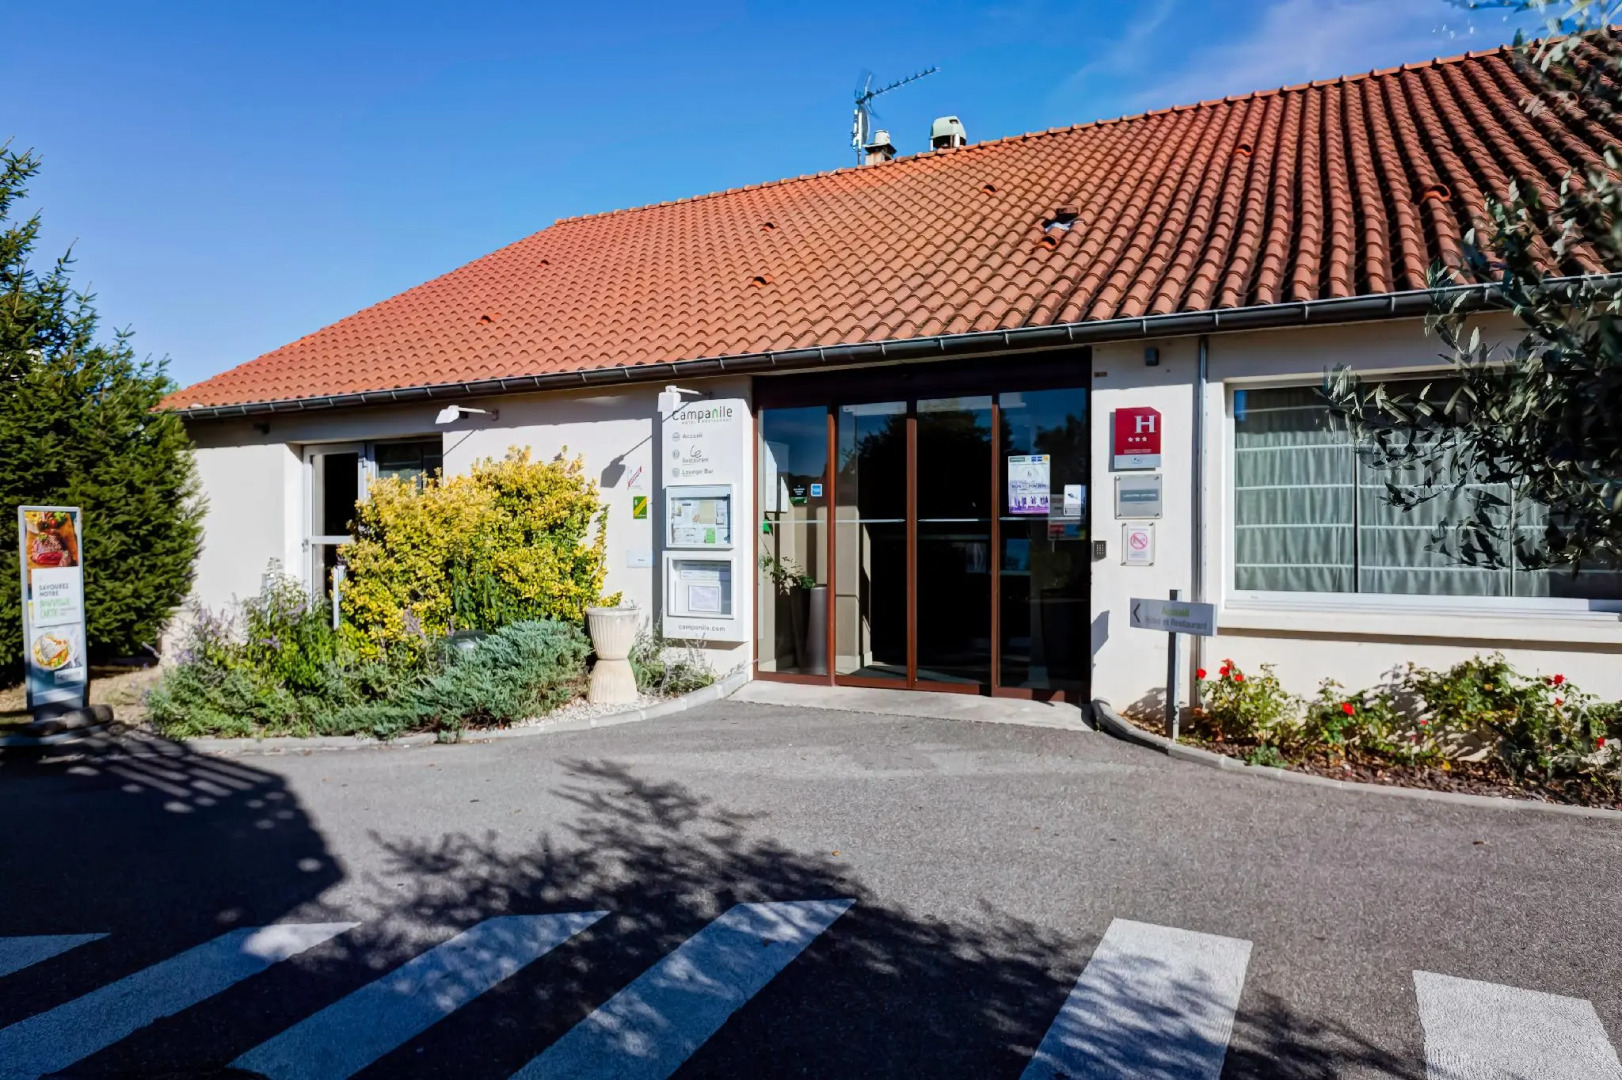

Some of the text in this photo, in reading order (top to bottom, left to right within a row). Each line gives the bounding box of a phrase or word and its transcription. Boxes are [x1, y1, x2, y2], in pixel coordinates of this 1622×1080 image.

[672, 405, 733, 423] Campanile
[1134, 415, 1156, 434] H
[39, 583, 69, 591] SAVOUREZ
